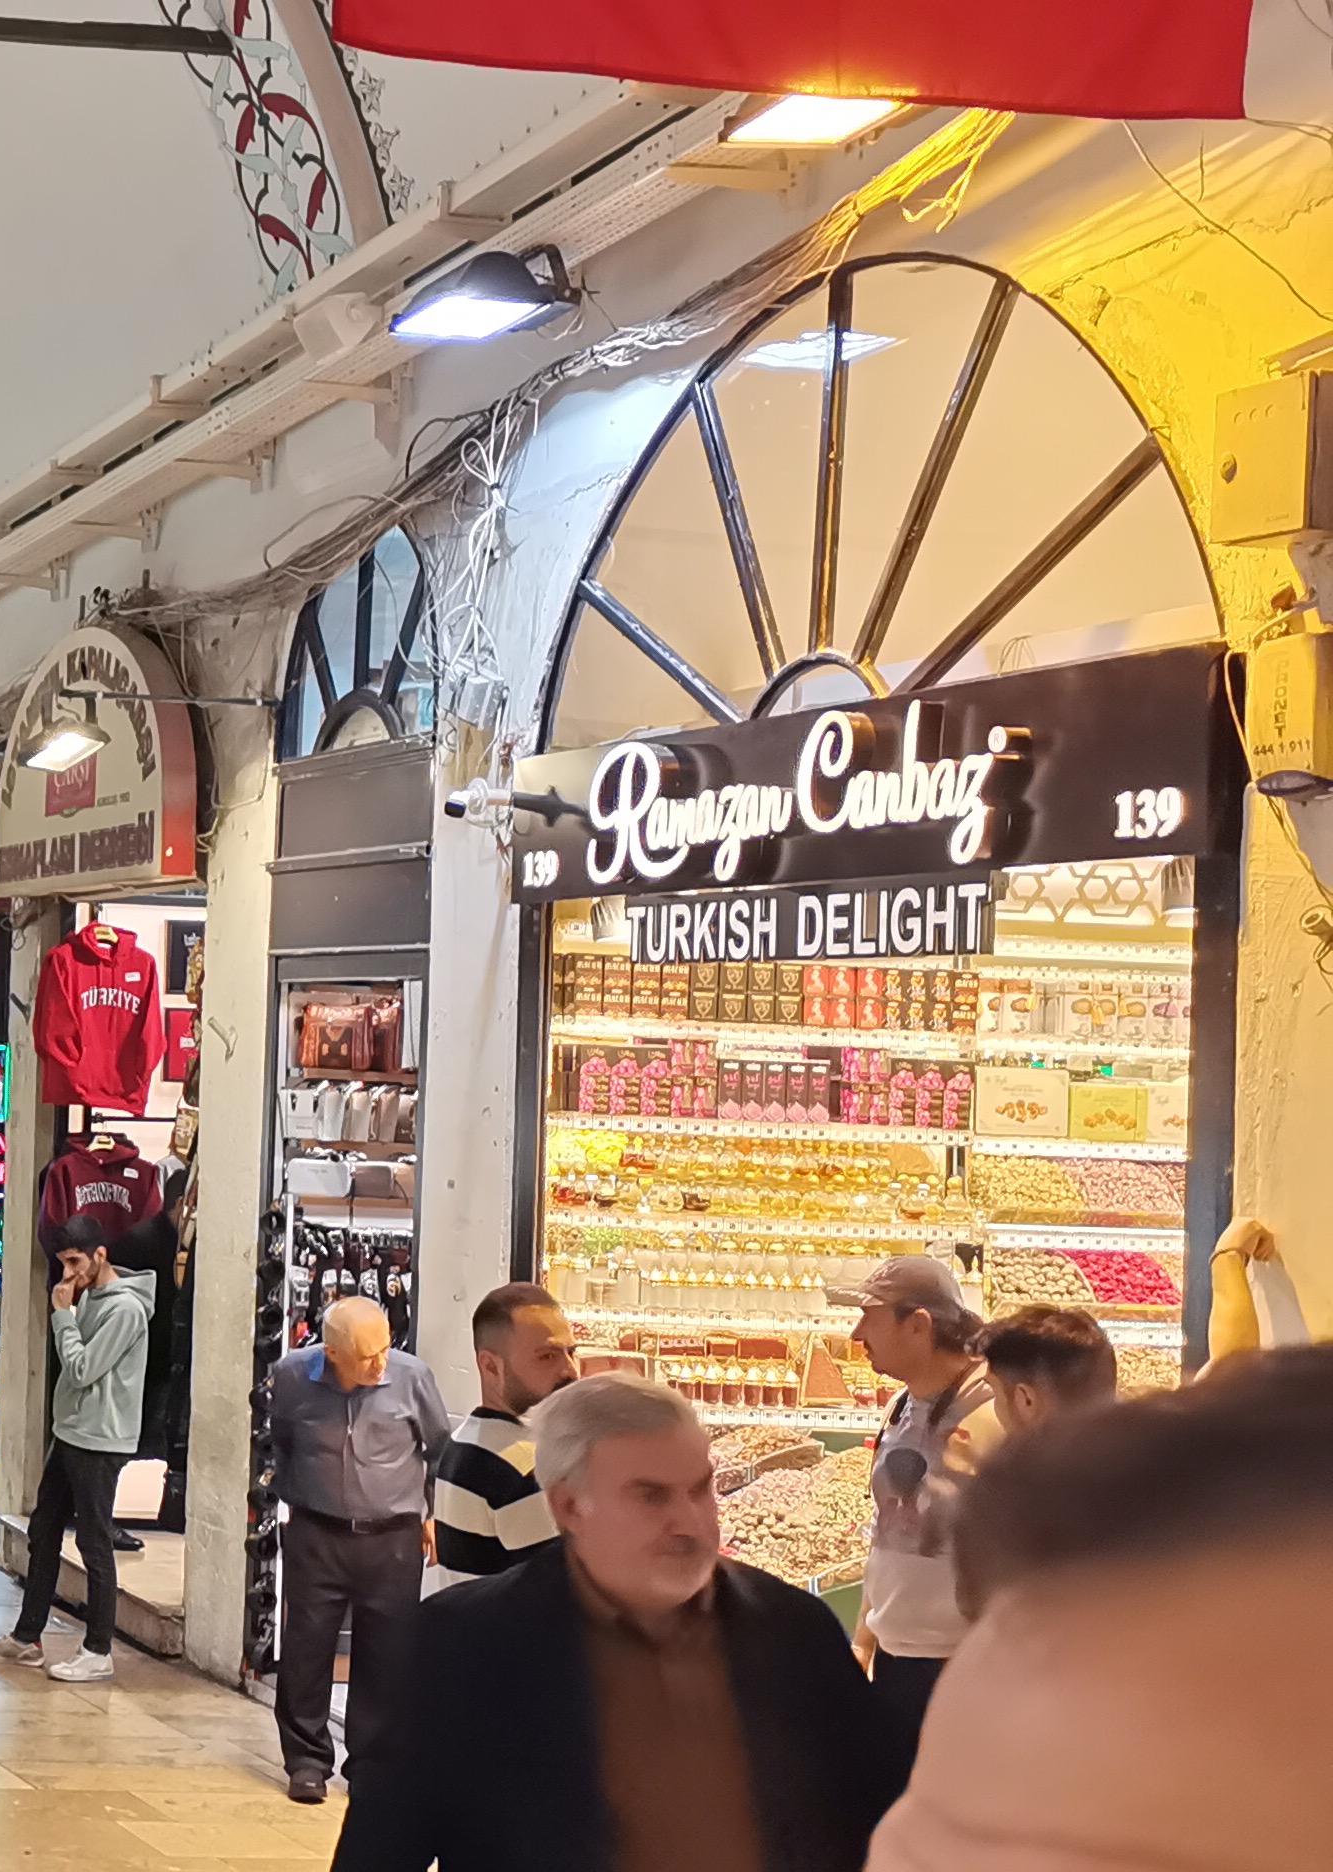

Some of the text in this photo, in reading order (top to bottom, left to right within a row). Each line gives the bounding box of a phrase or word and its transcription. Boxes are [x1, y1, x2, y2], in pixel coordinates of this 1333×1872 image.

[1252, 743, 1275, 757] 444
[1288, 738, 1312, 753] 911
[587, 699, 994, 884] Ramazan Canbaz
[1113, 786, 1184, 839] 139
[522, 850, 560, 888] 139
[626, 882, 987, 963] TURKISH DELIGHT
[80, 985, 141, 1014] TÜRKİYE
